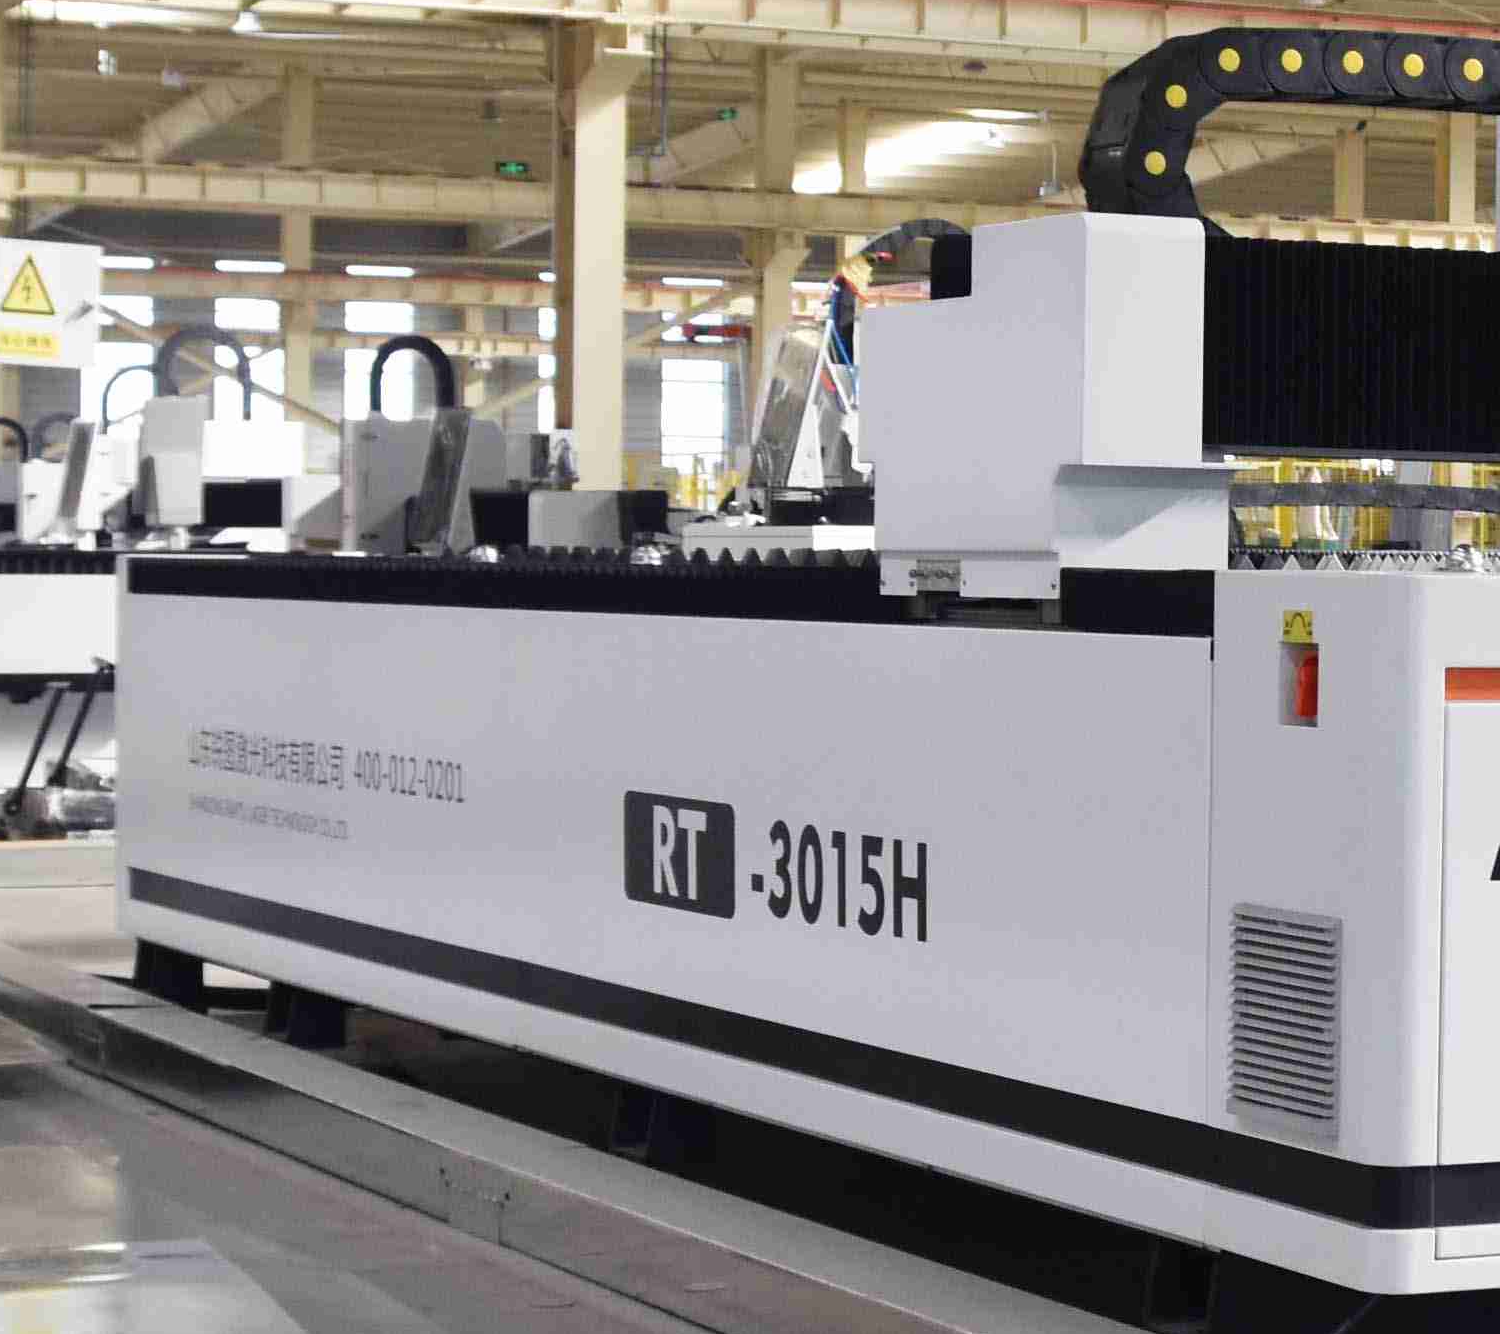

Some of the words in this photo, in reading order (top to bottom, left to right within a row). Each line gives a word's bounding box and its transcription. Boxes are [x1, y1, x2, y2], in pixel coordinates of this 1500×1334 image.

[354, 750, 465, 803] 400-012-0201
[652, 803, 707, 901] RT
[751, 820, 928, 943] -3015H
